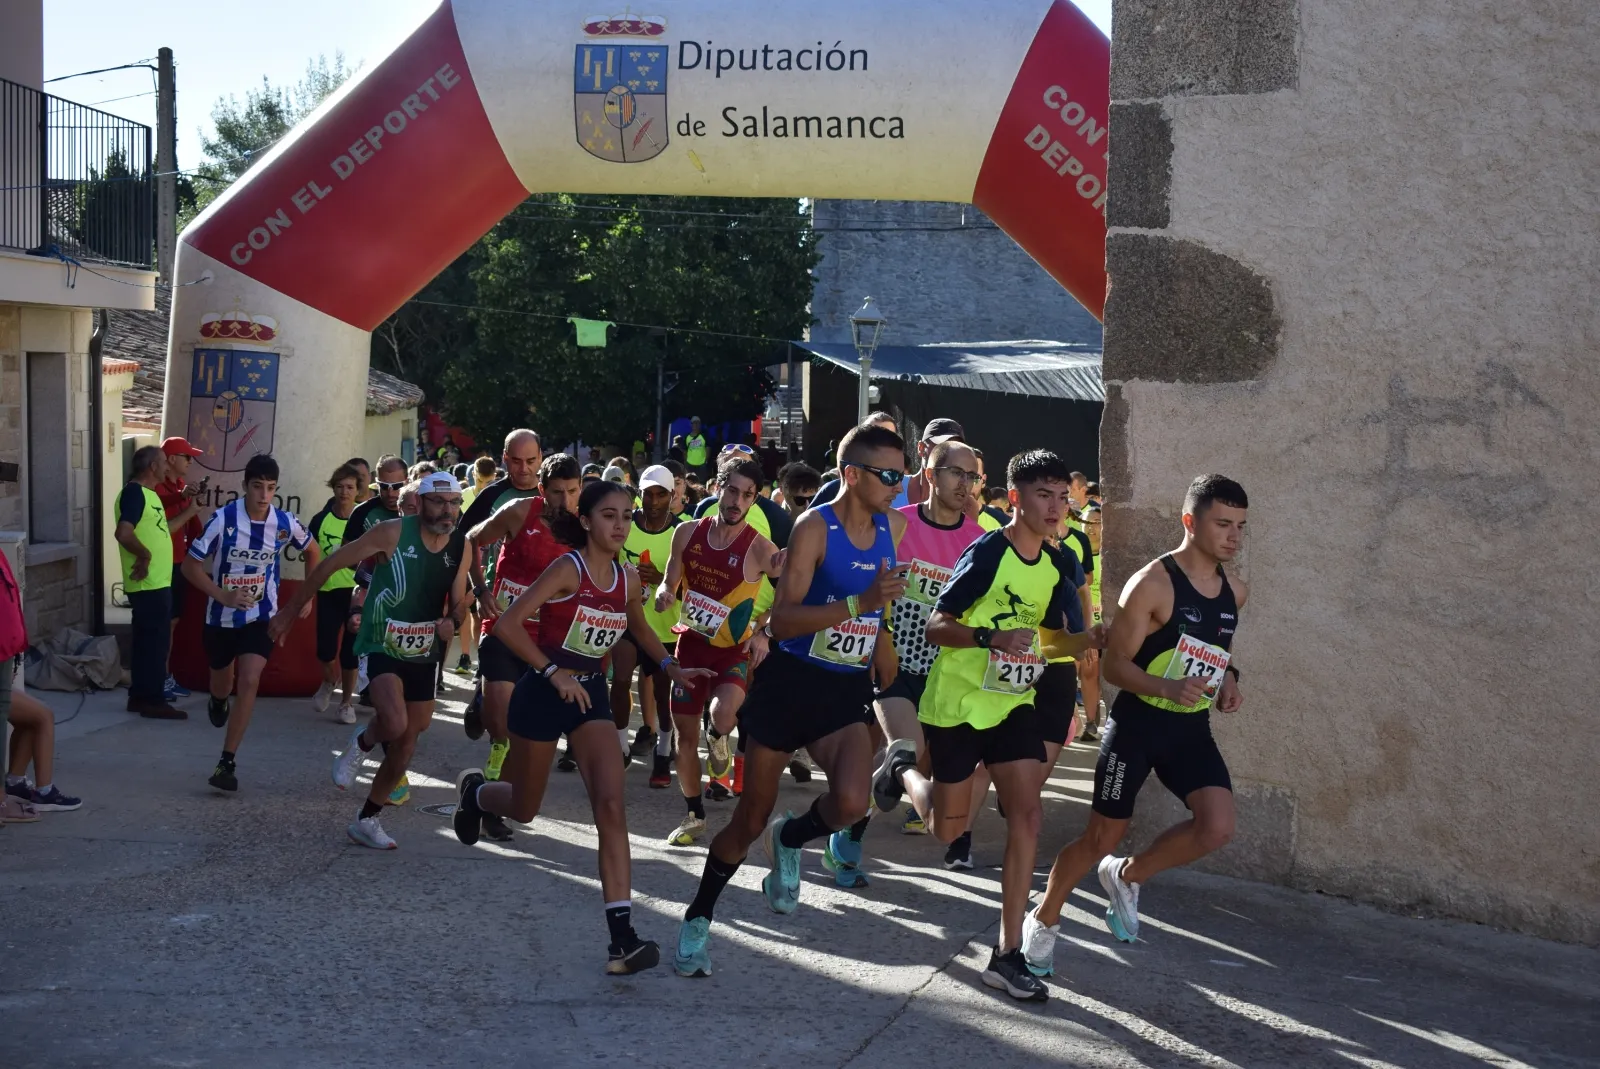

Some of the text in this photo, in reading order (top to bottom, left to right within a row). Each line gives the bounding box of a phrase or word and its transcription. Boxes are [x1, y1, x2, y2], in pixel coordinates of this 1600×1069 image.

[678, 40, 869, 78] Diputación
[676, 106, 905, 138] de Salamanca
[1043, 85, 1107, 147] CON
[230, 63, 461, 265] CON EL DEPORTE
[224, 575, 265, 585] bedunia
[918, 578, 946, 598] 15
[685, 593, 728, 619] bedunia
[687, 606, 714, 626] 241
[388, 623, 435, 635] bedunia
[575, 609, 627, 630] bedunia
[832, 620, 877, 636] edunia
[396, 635, 425, 650] 193
[584, 627, 617, 648] 183
[827, 632, 866, 655] 201
[1177, 637, 1228, 670] bedunia
[998, 664, 1035, 684] 213
[1183, 657, 1217, 678] 137
[1101, 751, 1117, 800] KIROL TALDEA
[1111, 761, 1126, 800] DURANGO
